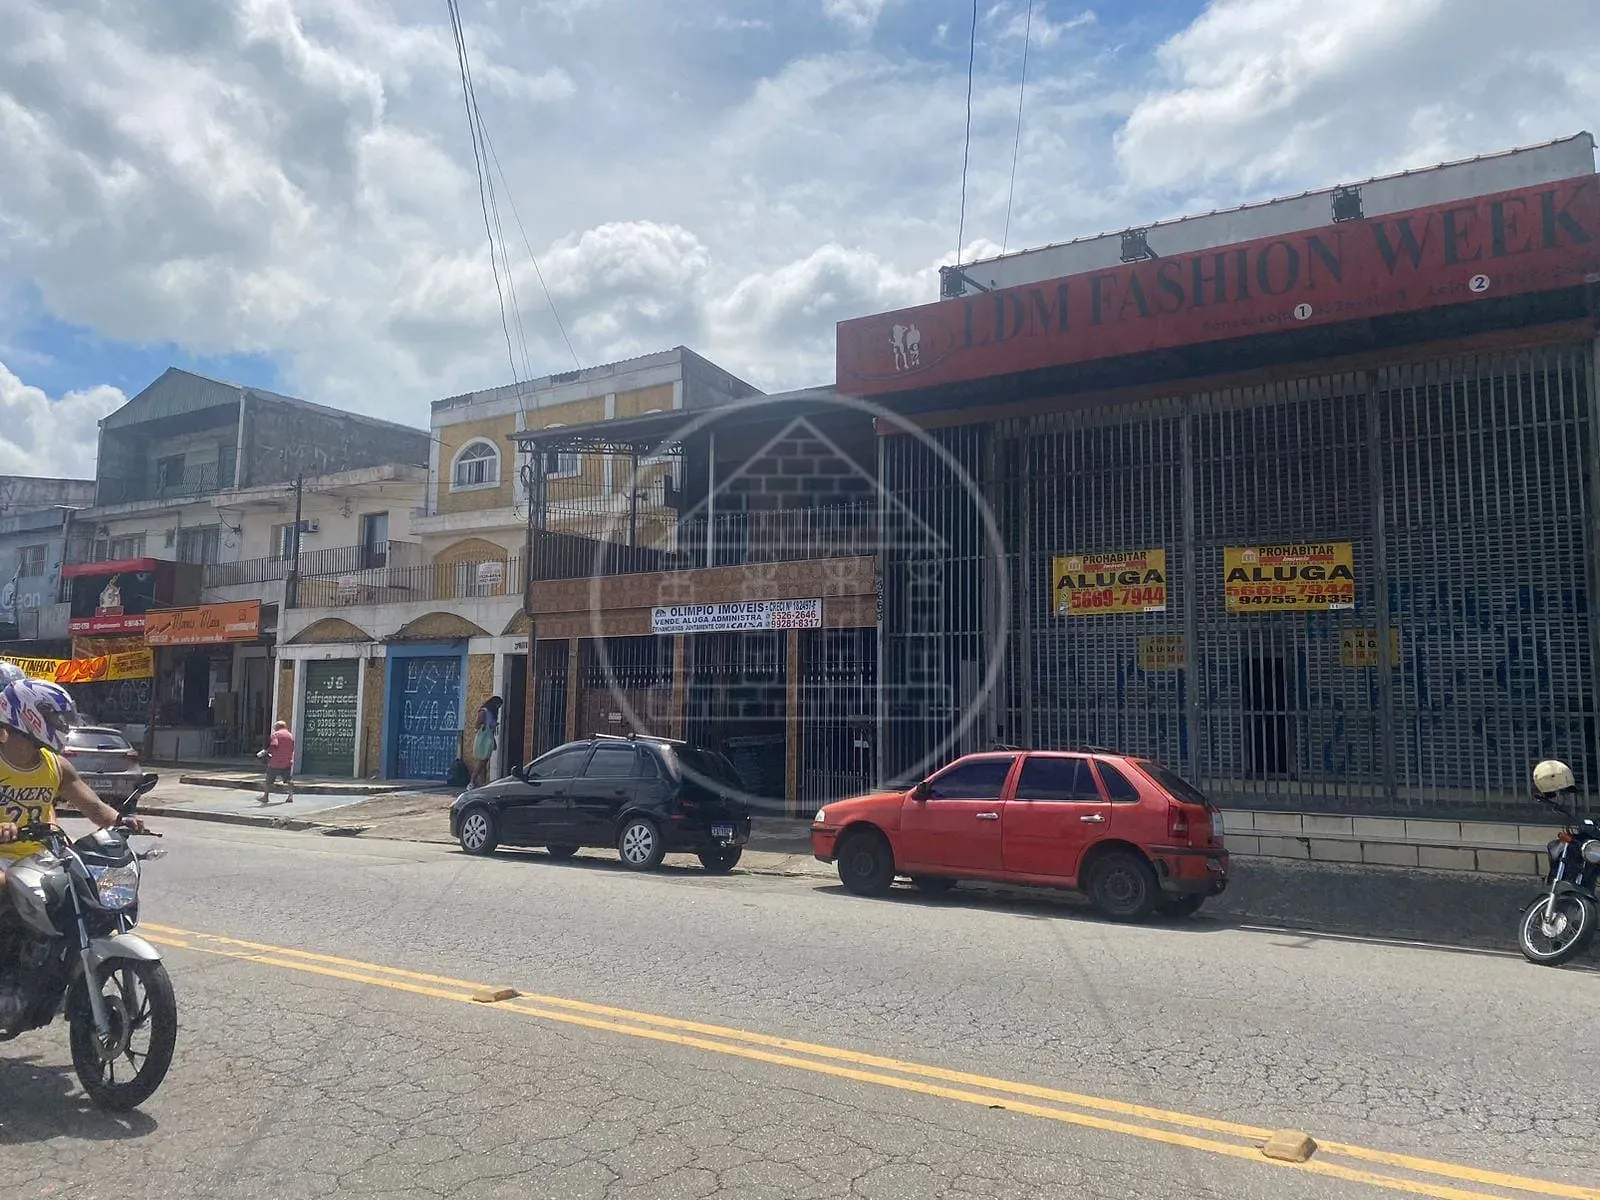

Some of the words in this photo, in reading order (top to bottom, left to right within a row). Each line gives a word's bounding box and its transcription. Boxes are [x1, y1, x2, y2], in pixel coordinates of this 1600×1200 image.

[963, 283, 1070, 348] LDM
[1089, 227, 1346, 327] FASHION
[1370, 180, 1594, 276] WEEK
[1259, 545, 1334, 557] PROHABITAR
[1083, 551, 1147, 564] PROHABITAR
[1056, 569, 1164, 589] ALUGA
[1226, 565, 1355, 582] ALUGA
[1226, 584, 1353, 596] 5669-7944
[1071, 587, 1165, 608] 5669-7944
[1239, 594, 1353, 605] 94755-7835
[670, 605, 714, 617] OLIMPIO
[771, 610, 816, 620] 5526-2646
[655, 618, 680, 626] VENDE
[682, 616, 709, 624] ALUGA
[771, 619, 819, 628] 99281-8317
